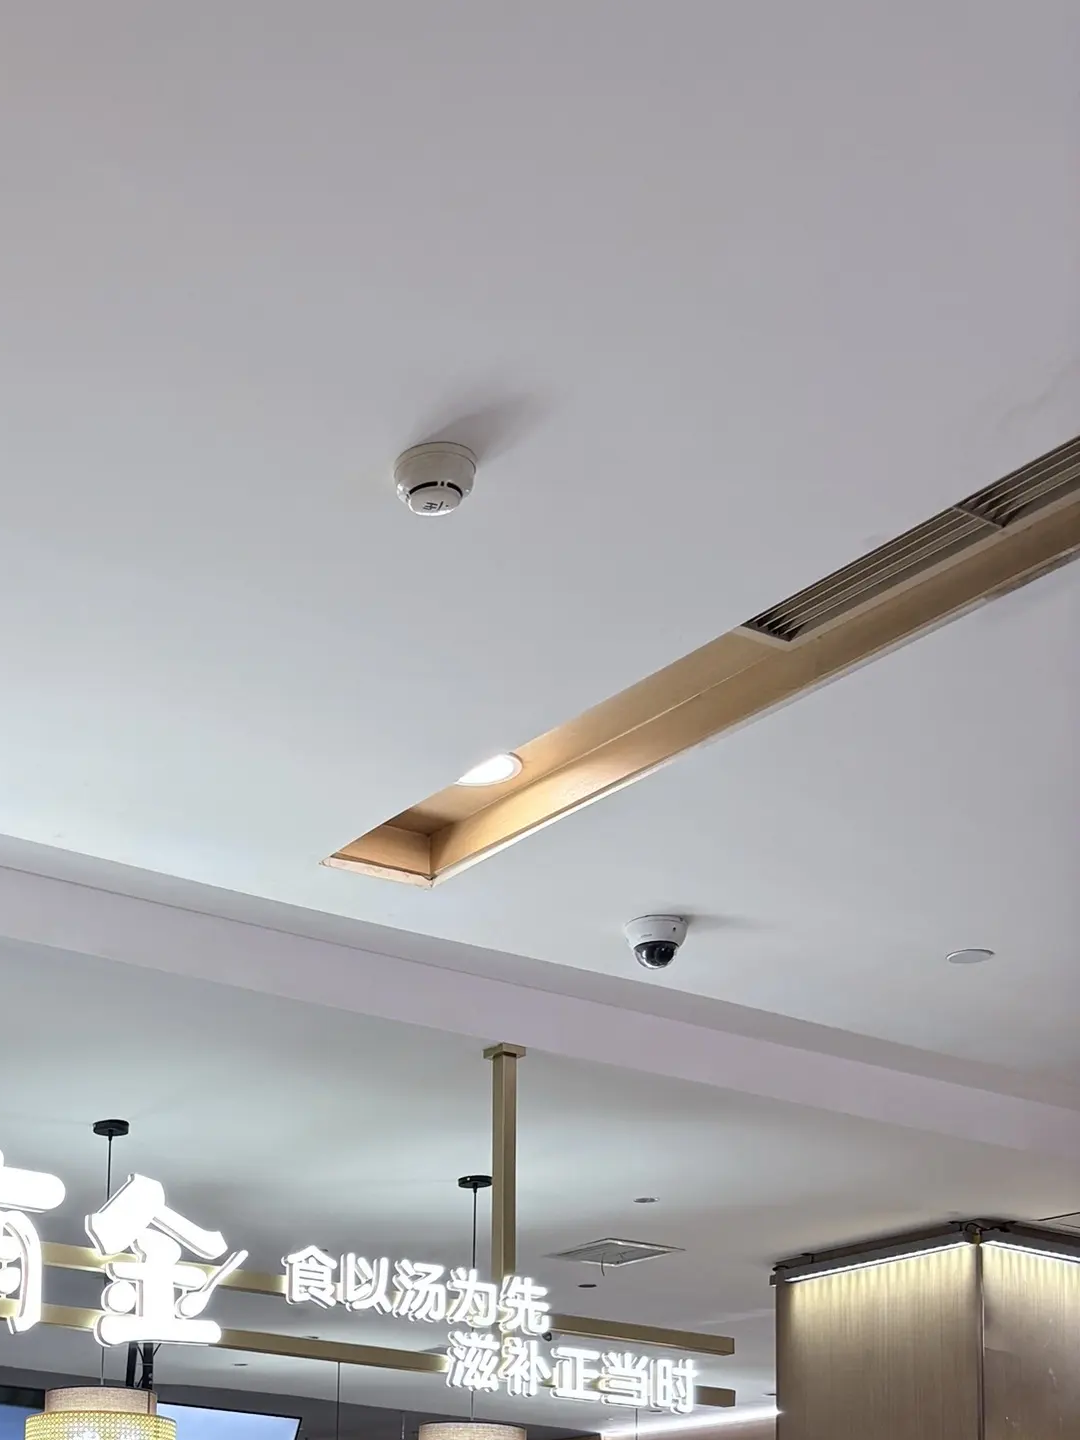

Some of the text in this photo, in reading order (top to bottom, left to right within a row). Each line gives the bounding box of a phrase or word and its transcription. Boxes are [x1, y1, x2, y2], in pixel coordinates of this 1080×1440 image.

[281, 1245, 552, 1335] 食以汤为先
[446, 1330, 697, 1414] 滋补正当时
